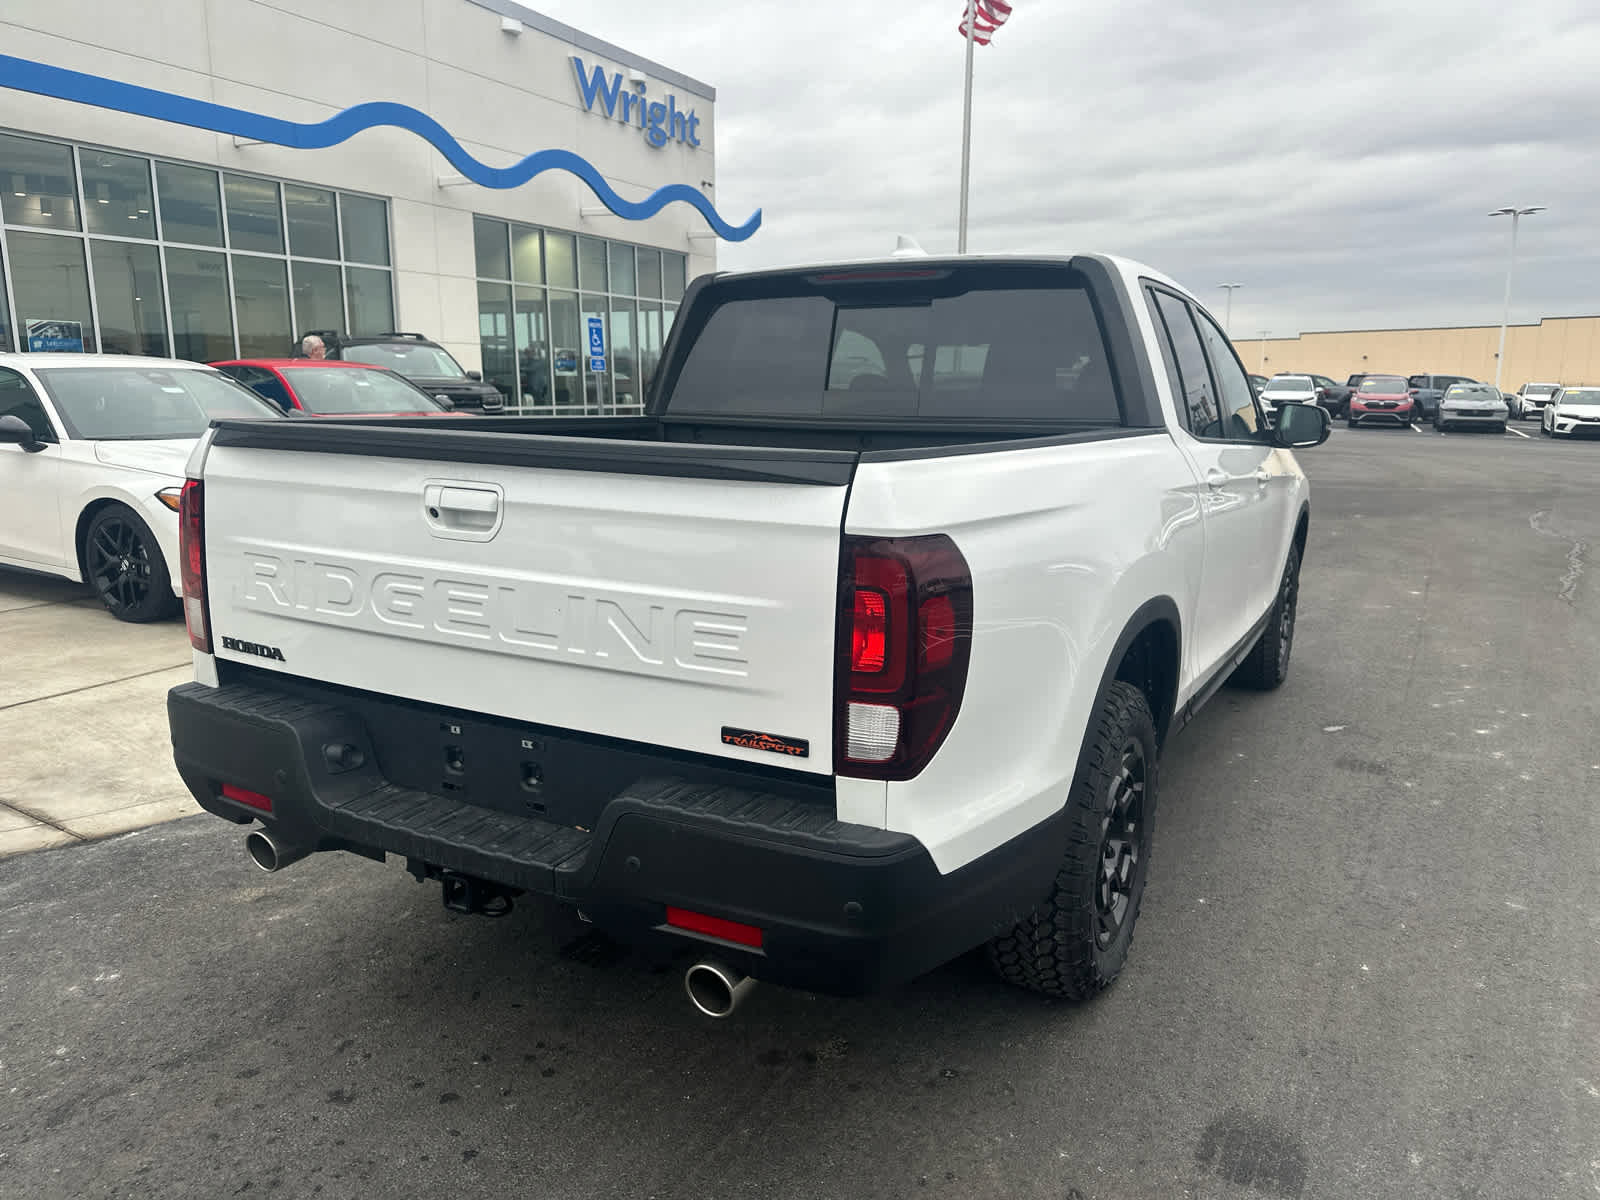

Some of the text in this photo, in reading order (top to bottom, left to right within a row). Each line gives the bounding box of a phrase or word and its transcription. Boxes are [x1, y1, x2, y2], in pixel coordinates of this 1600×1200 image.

[569, 56, 700, 147] Wright
[243, 551, 749, 677] RIDGELINE
[222, 636, 286, 661] HONDA
[723, 735, 804, 755] TRAILSPORT
